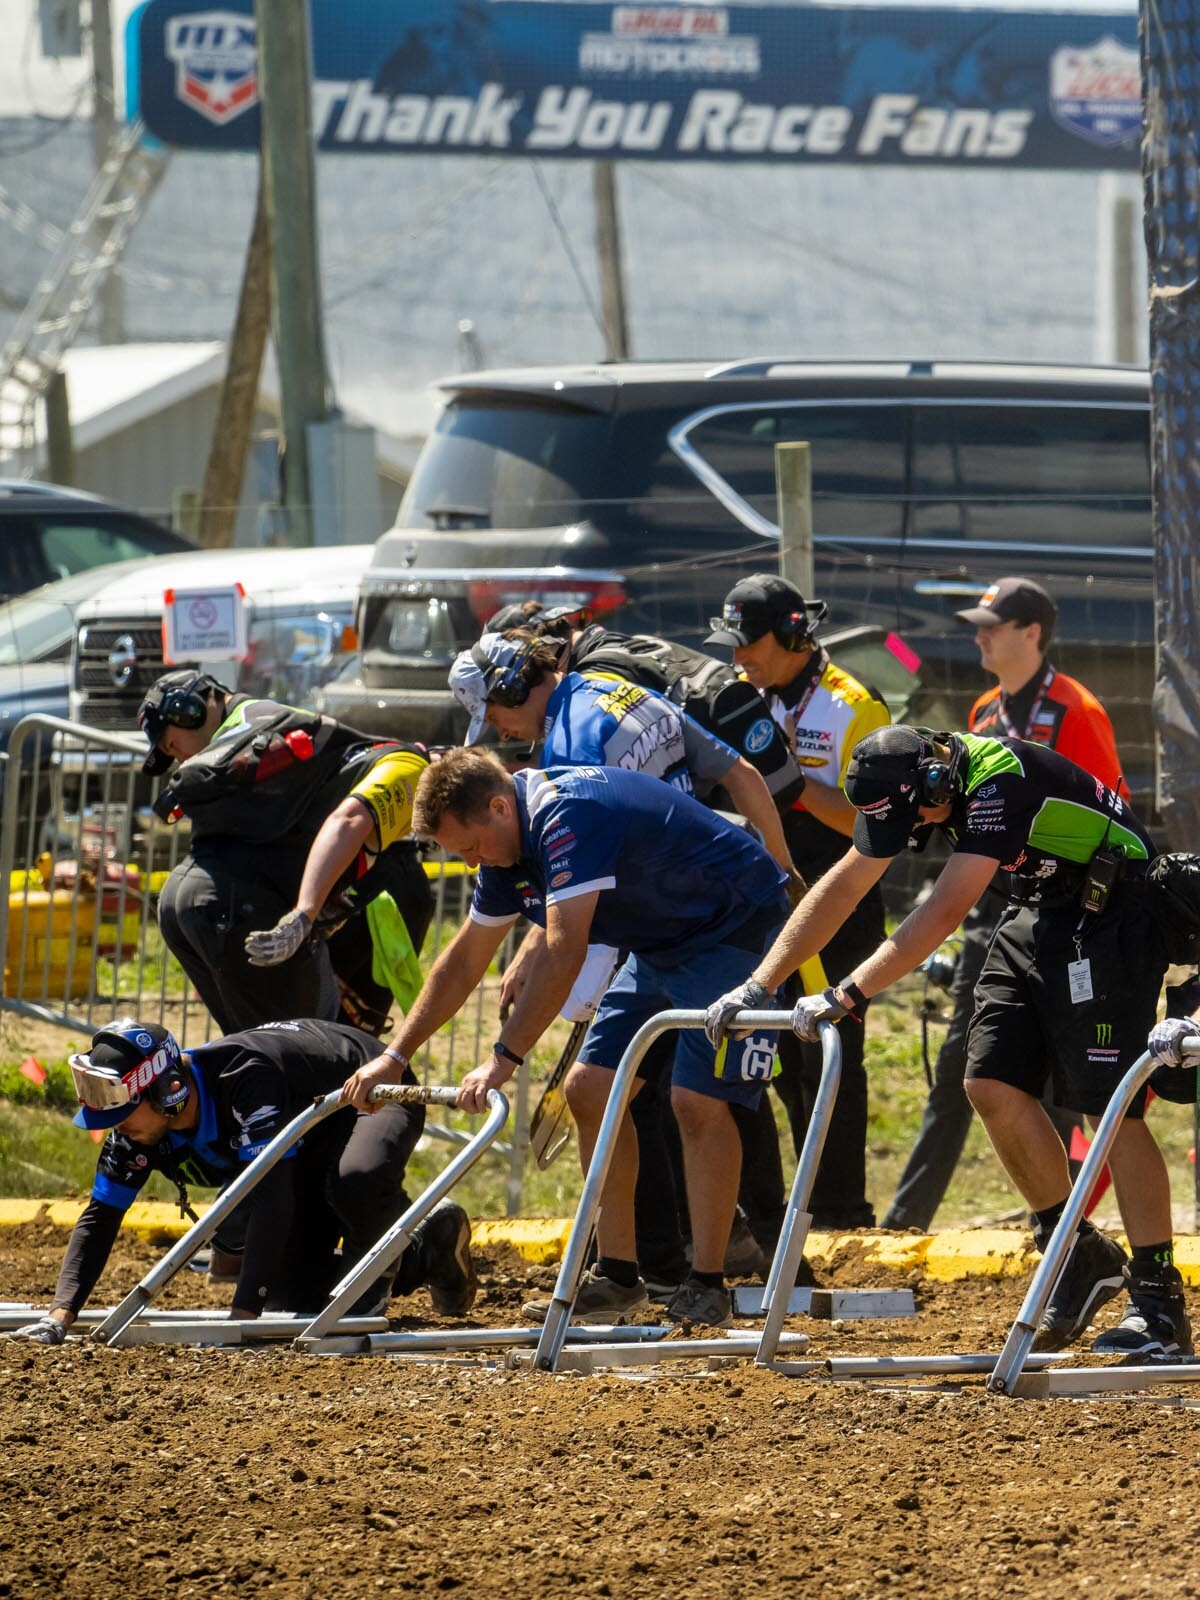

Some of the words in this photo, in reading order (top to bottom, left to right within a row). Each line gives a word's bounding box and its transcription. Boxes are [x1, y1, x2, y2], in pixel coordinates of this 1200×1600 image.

[313, 79, 521, 147] Thank
[526, 86, 673, 150] You
[677, 90, 852, 154] Race
[858, 94, 1033, 157] Fans
